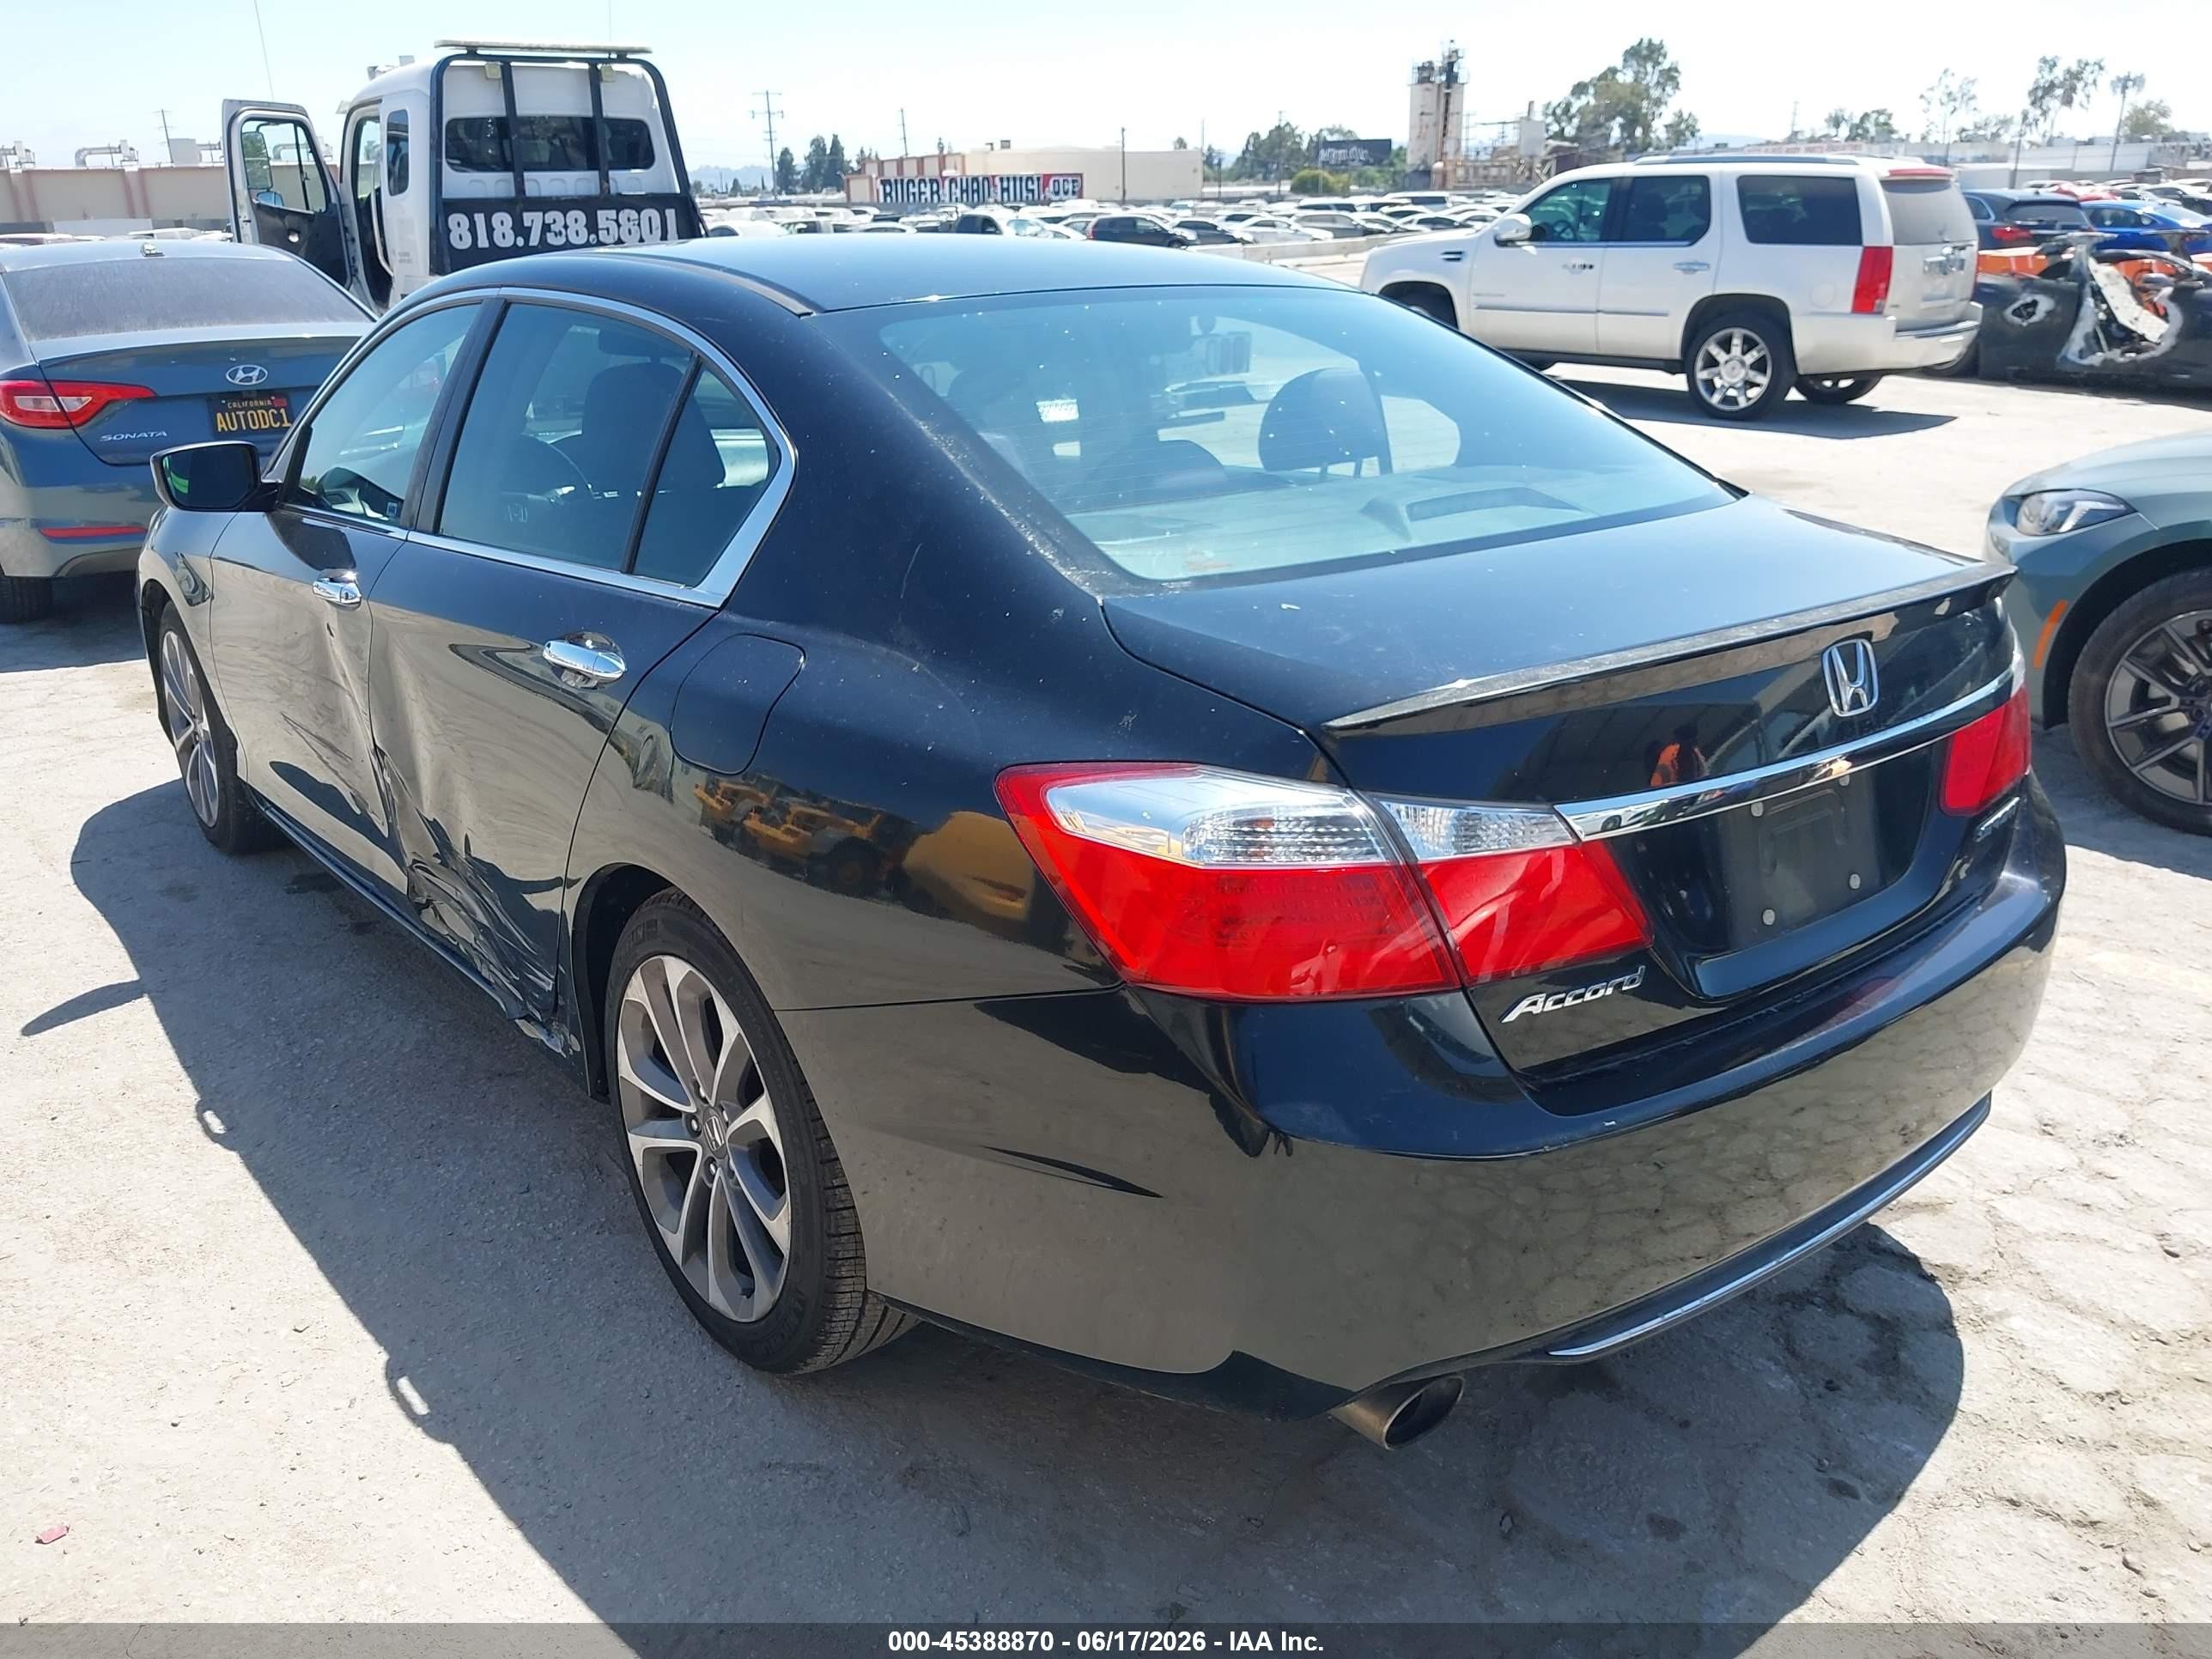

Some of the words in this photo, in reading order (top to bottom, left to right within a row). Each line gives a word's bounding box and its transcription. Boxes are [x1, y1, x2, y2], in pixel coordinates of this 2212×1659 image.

[447, 208, 679, 250] 818.738.5801
[227, 398, 273, 409] CALIFORNIA
[216, 407, 292, 432] AUTODC1
[99, 430, 167, 442] SONATA
[1499, 964, 1646, 1024] Accord
